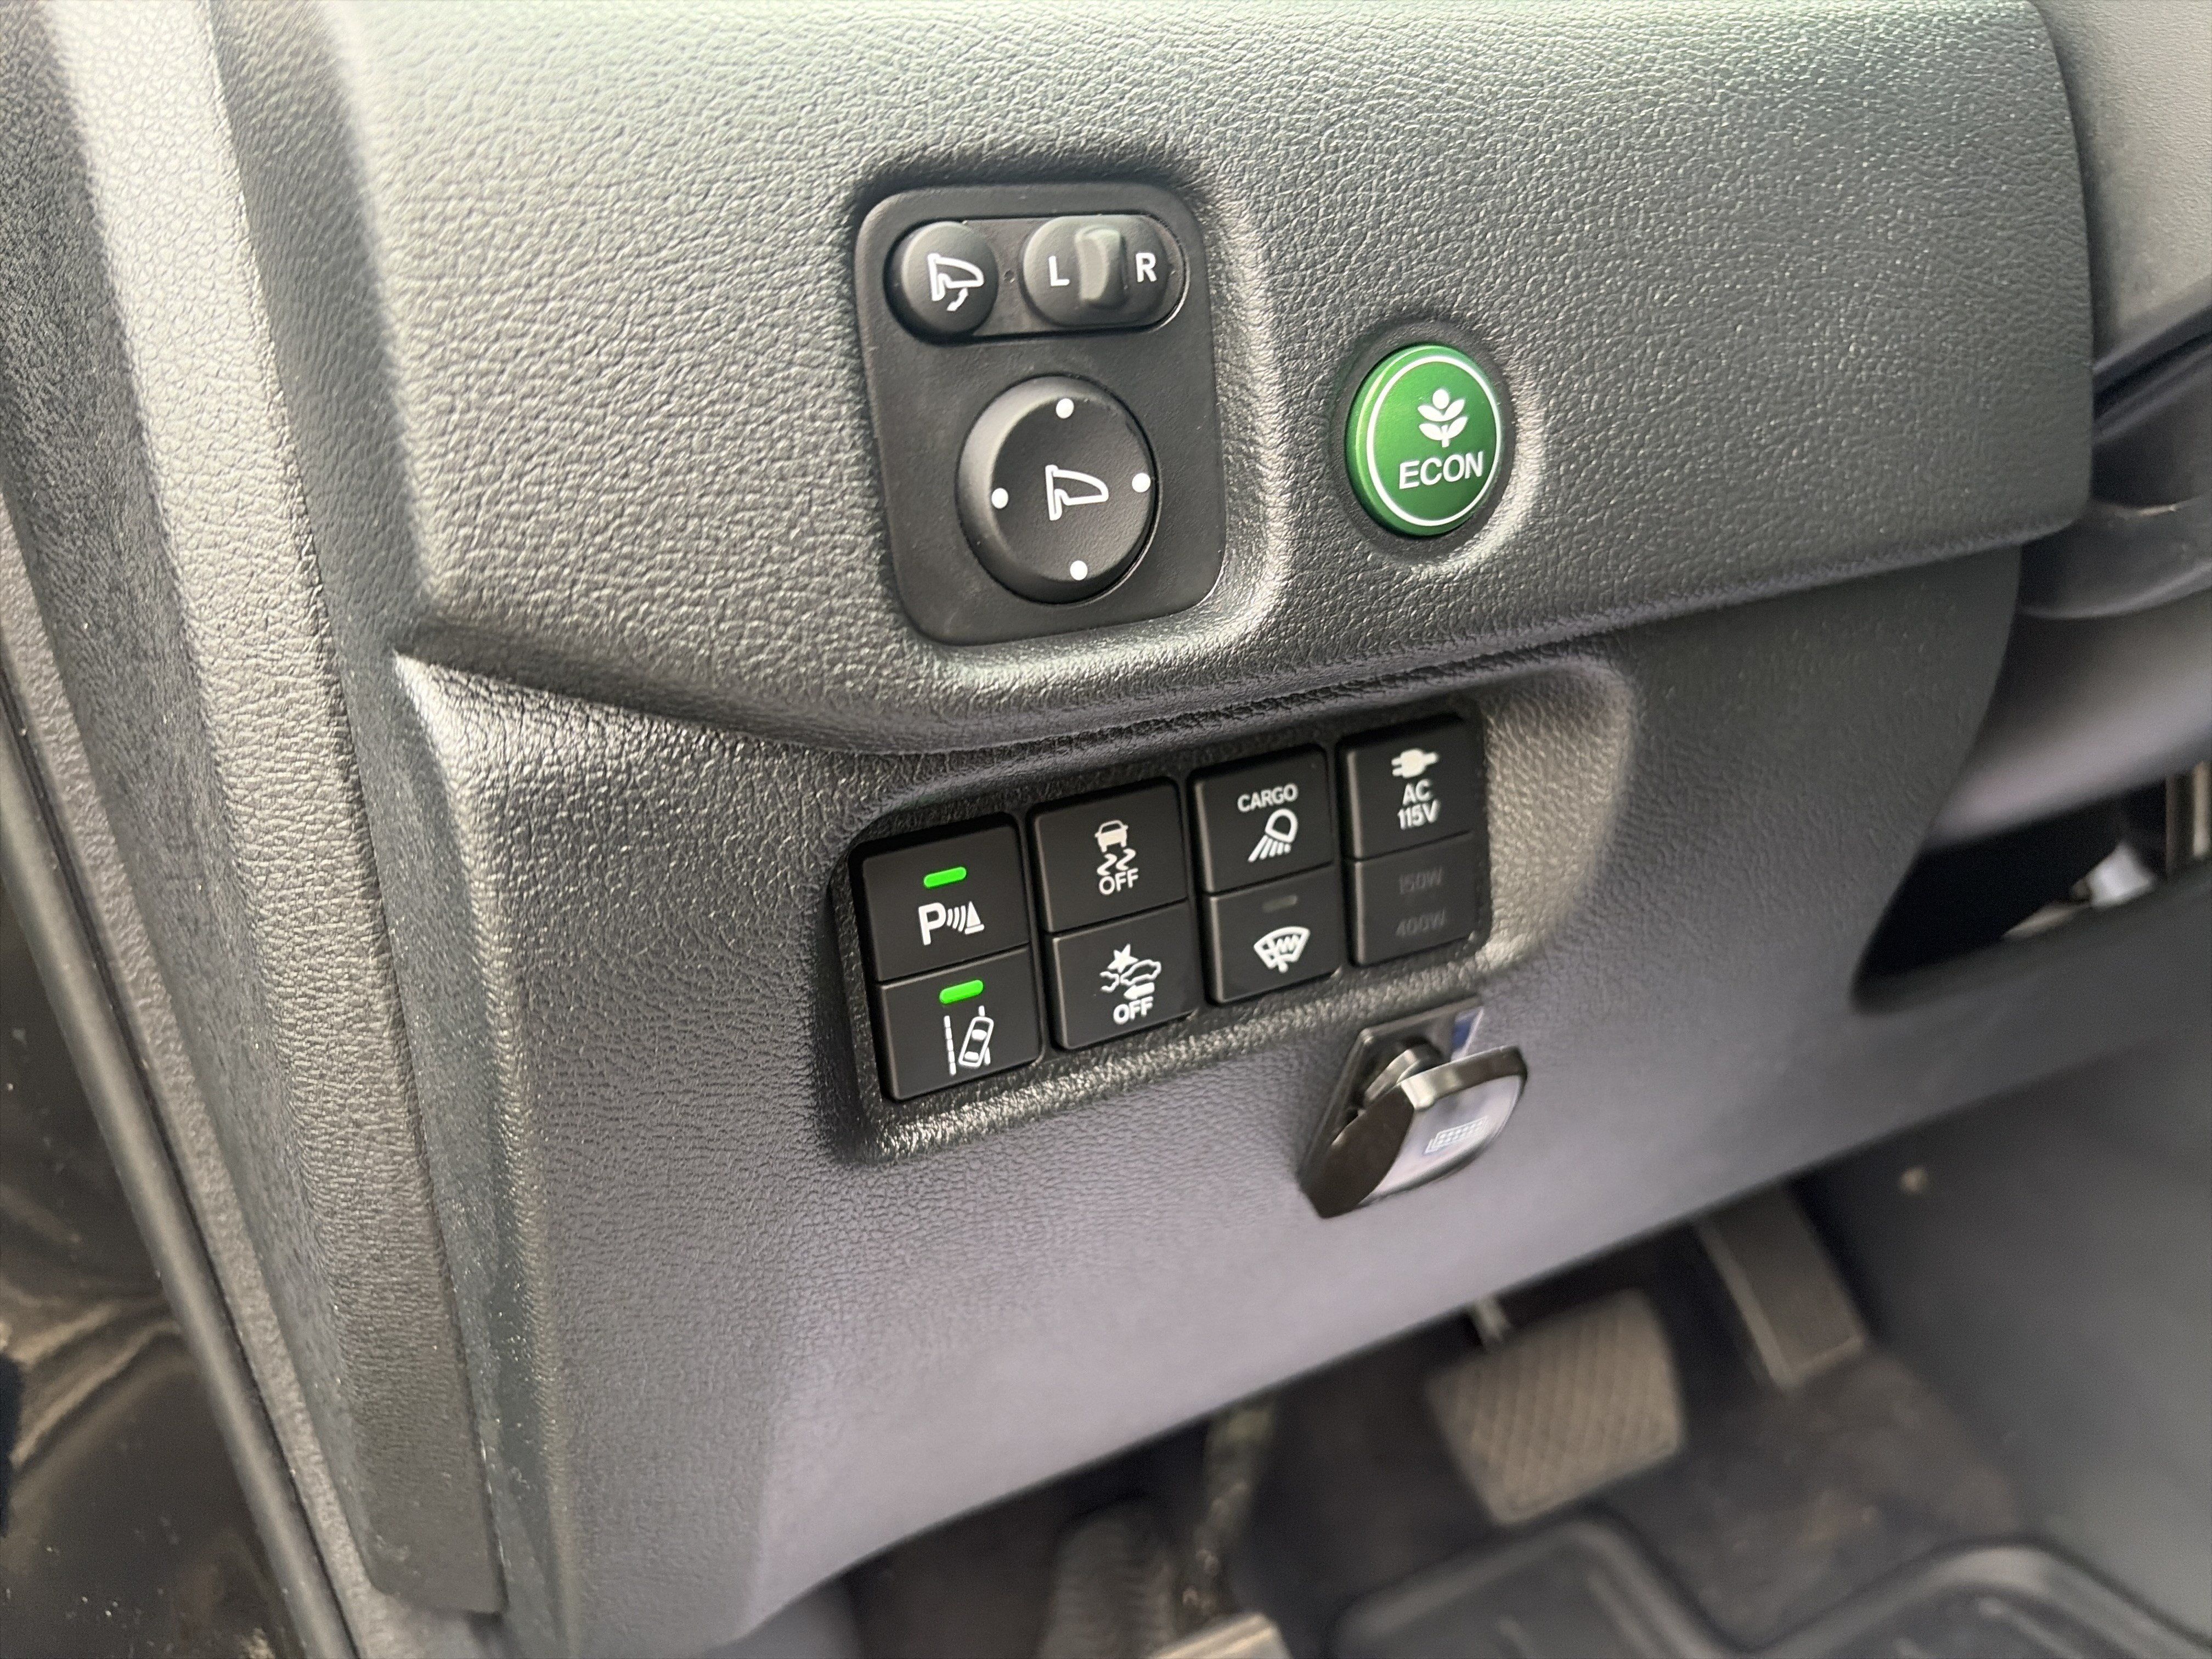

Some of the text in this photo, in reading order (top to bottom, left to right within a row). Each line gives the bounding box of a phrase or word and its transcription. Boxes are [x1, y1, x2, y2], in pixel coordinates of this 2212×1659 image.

[1048, 254, 1070, 287] L
[1135, 251, 1158, 283] R
[1398, 451, 1484, 490] ECON
[1237, 783, 1299, 812] CARGO
[1402, 779, 1432, 806] AC
[1397, 801, 1439, 830] 115V
[1098, 868, 1138, 895] OFF
[1113, 996, 1153, 1025] OFF
